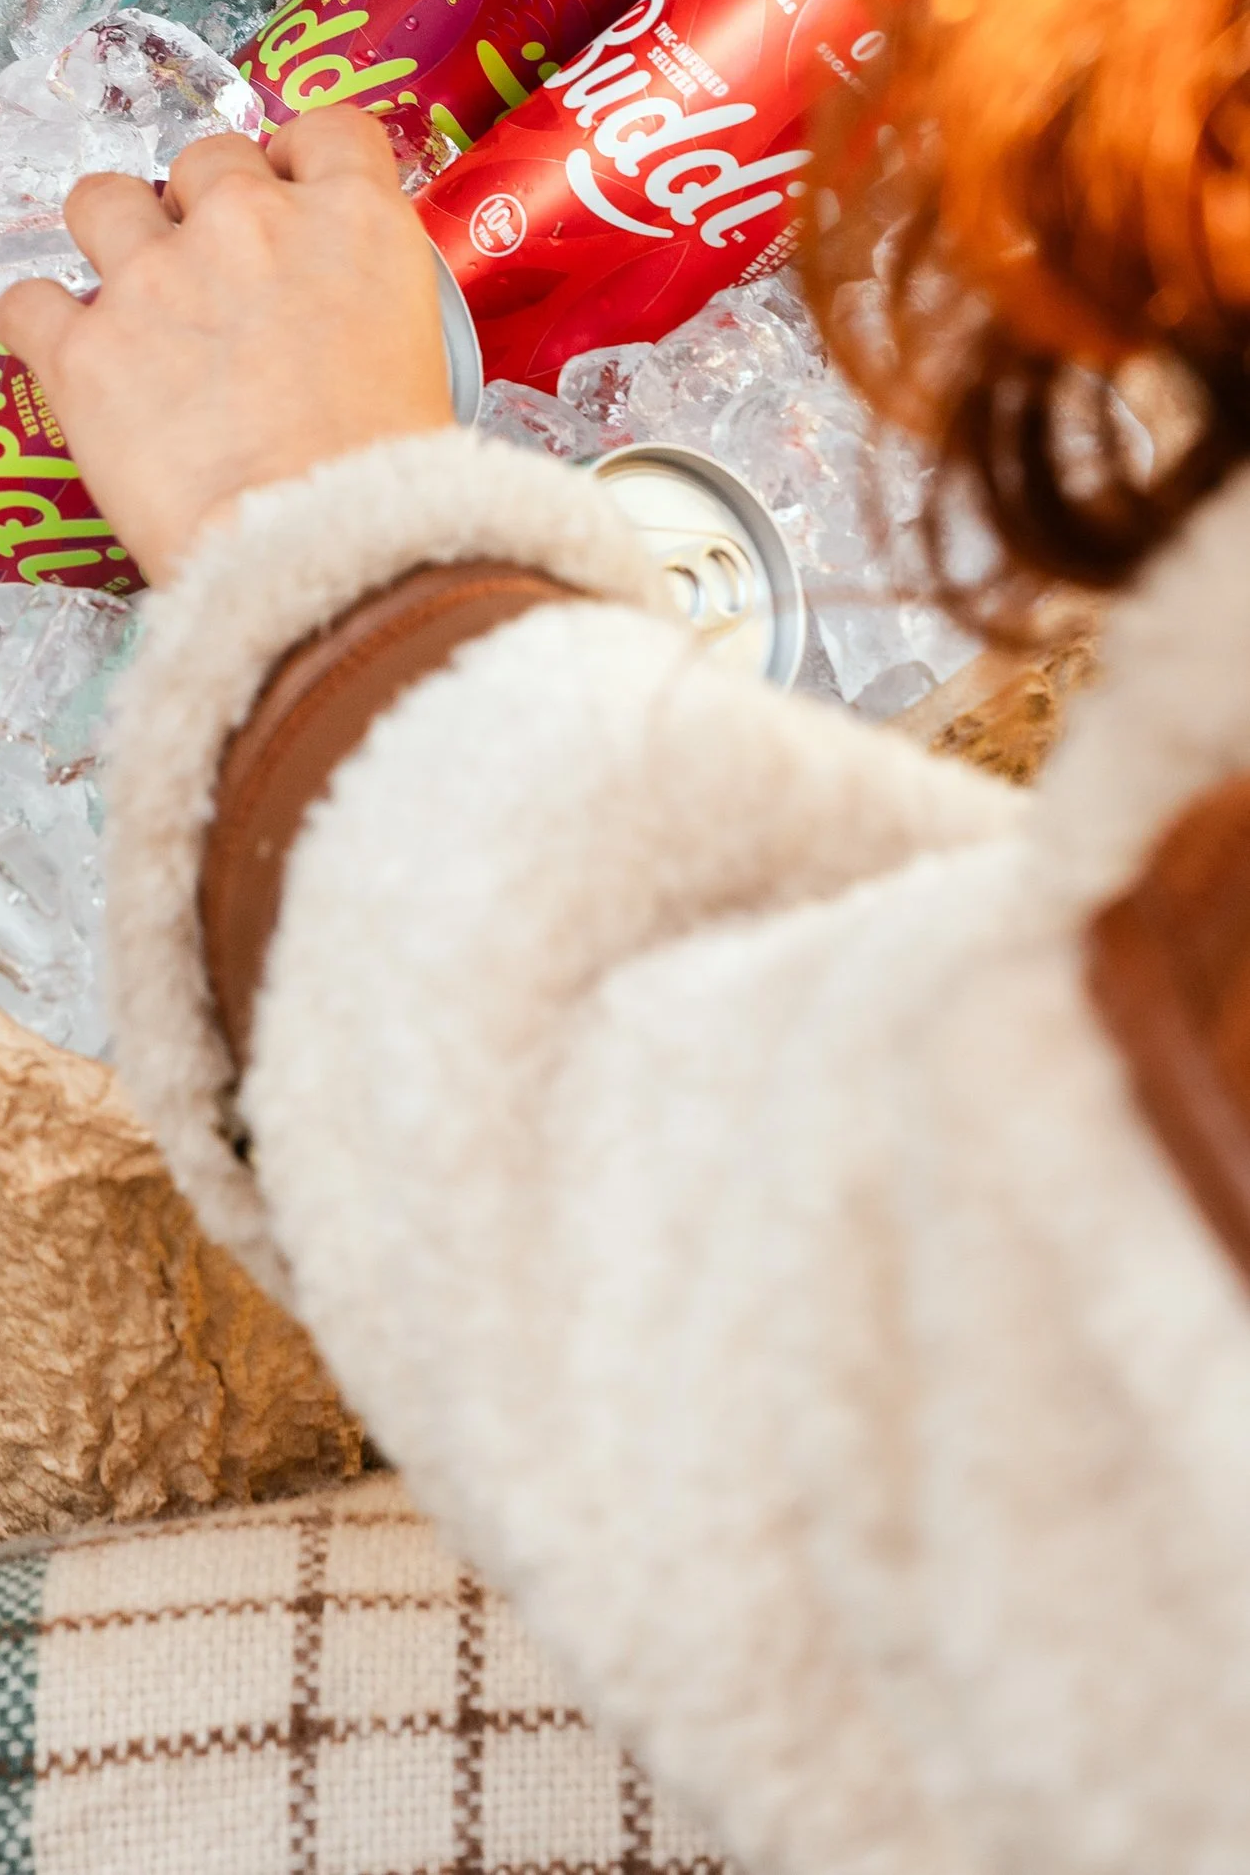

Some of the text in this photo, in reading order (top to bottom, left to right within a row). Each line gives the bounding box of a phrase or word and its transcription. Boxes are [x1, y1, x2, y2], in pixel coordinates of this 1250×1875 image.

[646, 46, 698, 98] SELTZER
[654, 21, 730, 98] THC-INFUSED
[851, 31, 887, 61] 0
[475, 223, 495, 249] THC
[10, 373, 41, 438] SELTZER
